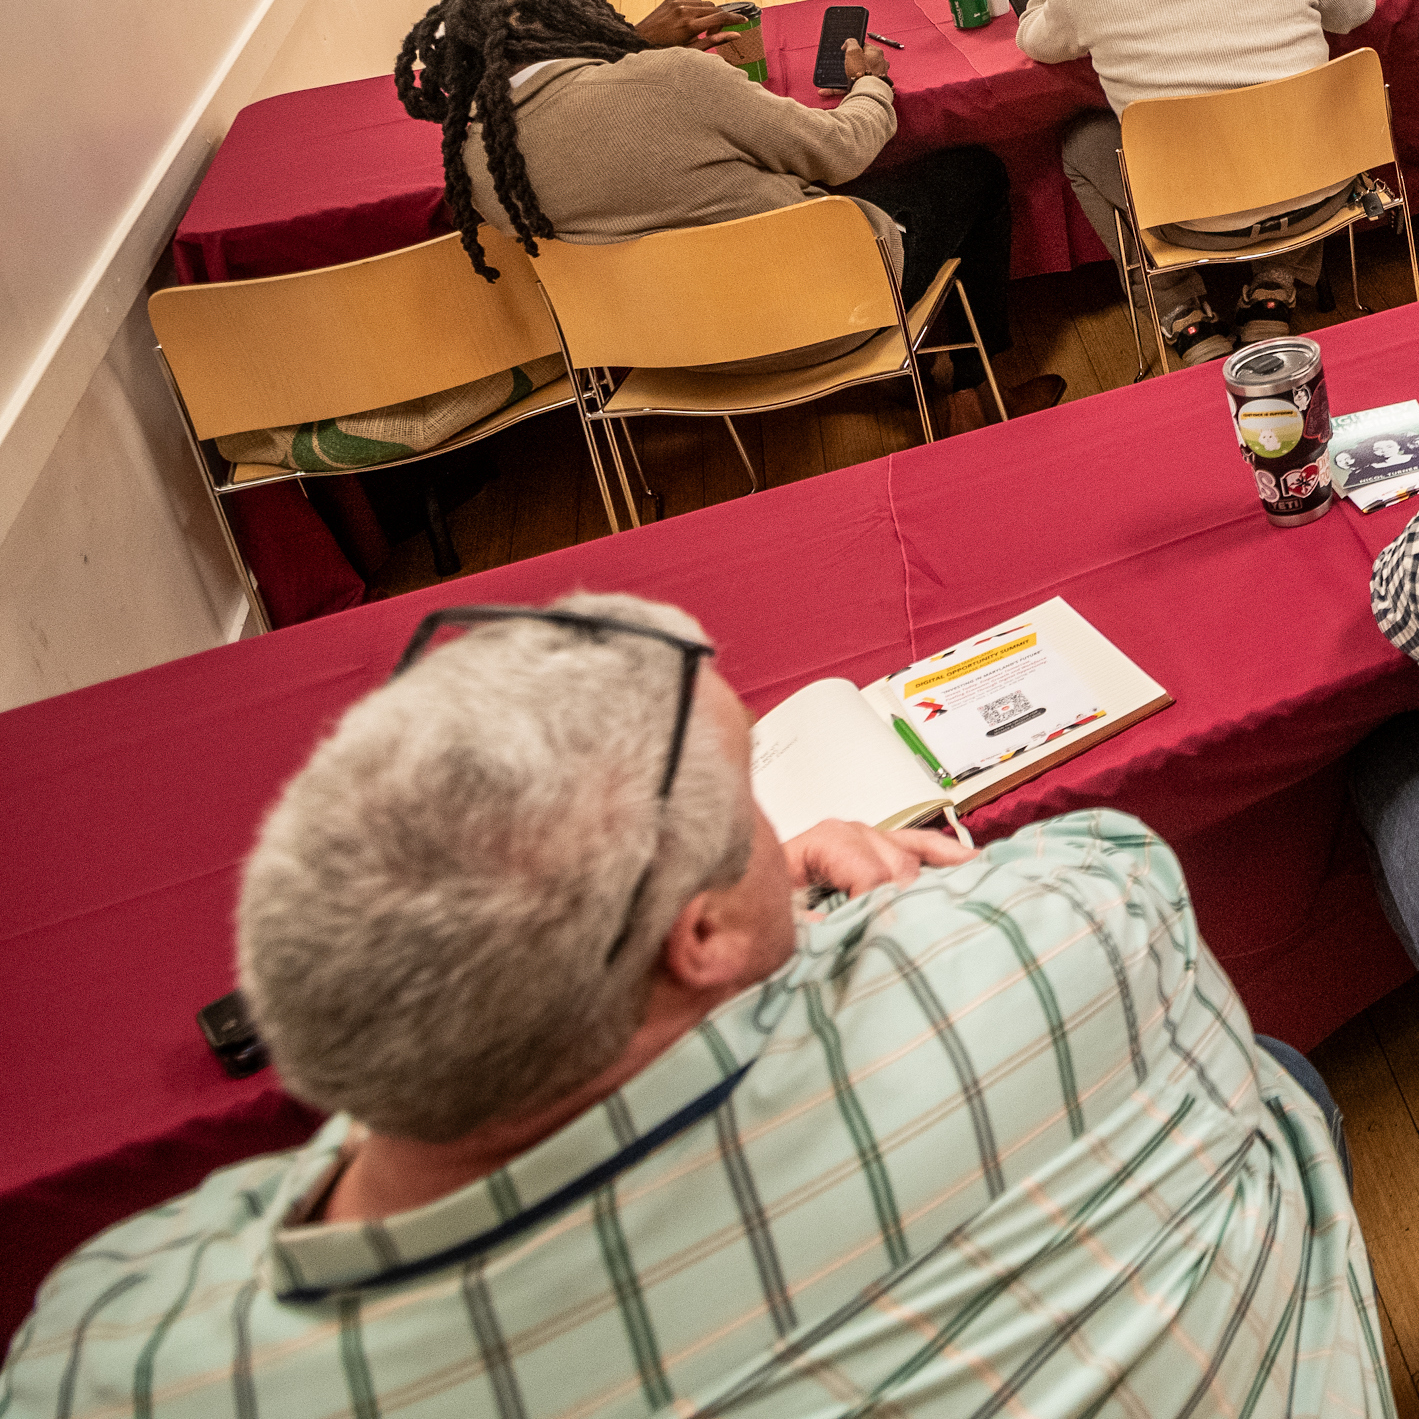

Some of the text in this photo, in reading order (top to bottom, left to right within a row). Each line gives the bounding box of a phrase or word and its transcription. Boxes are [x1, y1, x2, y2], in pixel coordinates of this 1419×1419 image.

[1331, 403, 1408, 426] IGITALLY
[1388, 466, 1418, 478] TURNER
[1272, 500, 1299, 510] YETI
[915, 640, 1029, 688] DIGITAL OPPORTUNITY SUMMIT
